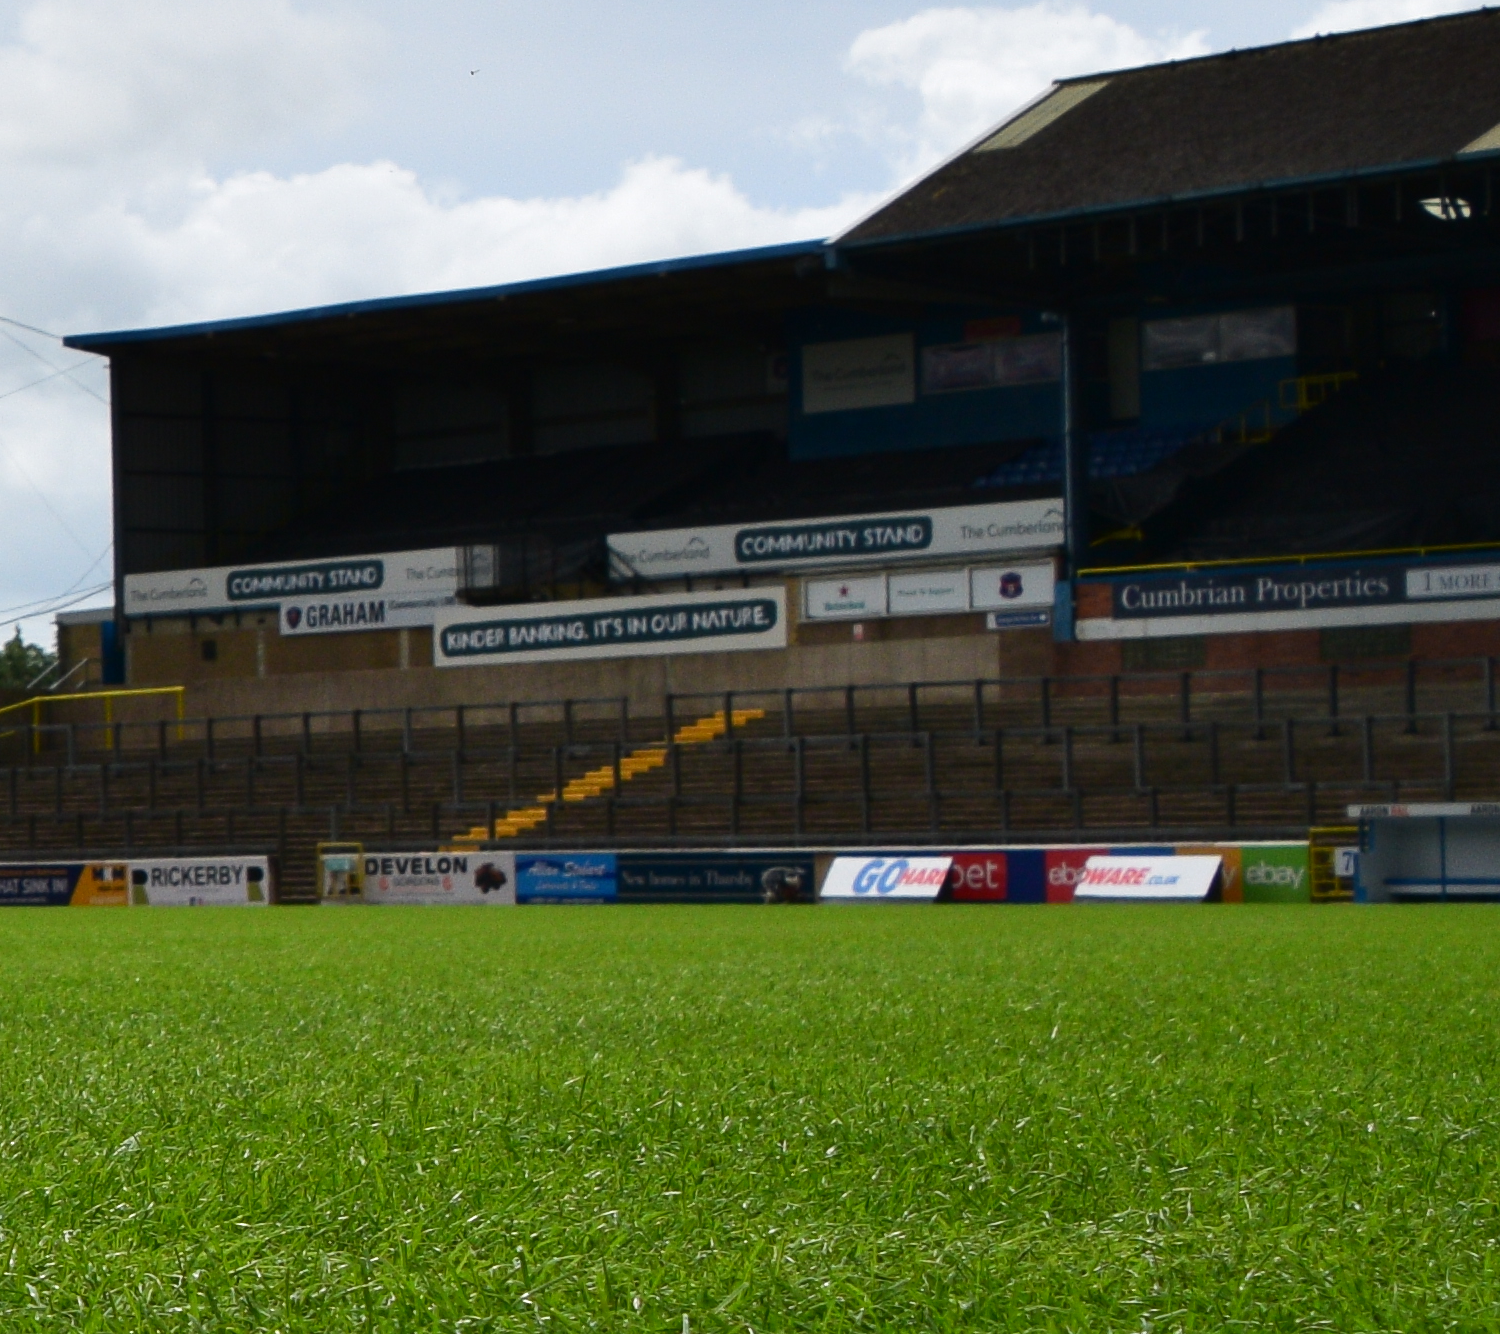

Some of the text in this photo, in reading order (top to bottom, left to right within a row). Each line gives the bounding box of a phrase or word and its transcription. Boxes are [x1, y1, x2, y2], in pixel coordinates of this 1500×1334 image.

[742, 525, 924, 554] COMMUNITY STAND
[961, 525, 985, 540] The
[231, 567, 377, 594] COMMUNITY STAND
[1122, 570, 1390, 609] Cumbrian Properties
[306, 601, 386, 627] GRAHAM
[446, 605, 770, 650] KINDER BANKING. IT'S IN OUR NATURE.
[365, 857, 468, 875] DEVELON
[1246, 859, 1304, 890] ebay
[1342, 851, 1352, 872] 7
[22, 878, 50, 894] SINK
[151, 864, 244, 887] RICKERBY
